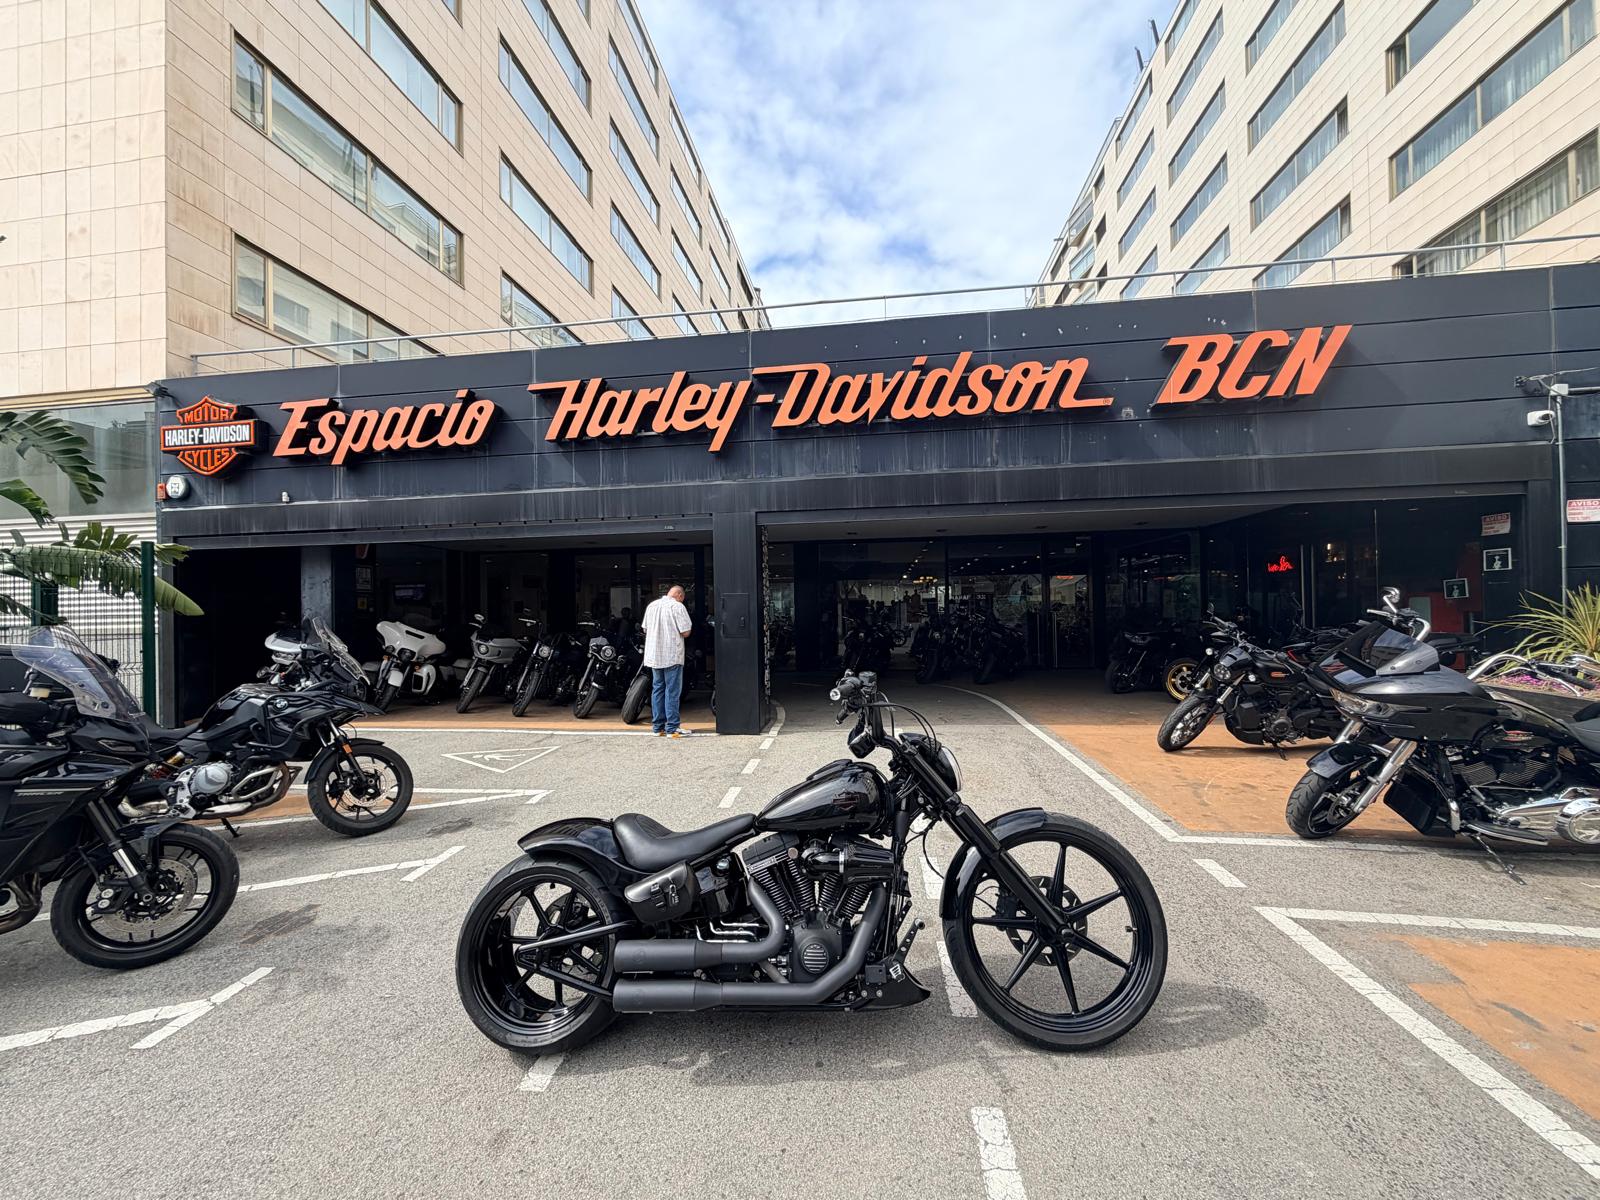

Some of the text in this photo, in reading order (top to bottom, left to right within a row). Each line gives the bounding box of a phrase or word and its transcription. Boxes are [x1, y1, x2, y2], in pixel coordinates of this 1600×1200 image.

[272, 324, 1353, 466] Espacio Harley-Davidson BCN
[183, 402, 230, 424] MOTOR
[164, 424, 251, 447] HARLEY-DAVIDSON
[183, 447, 231, 471] CYCLES
